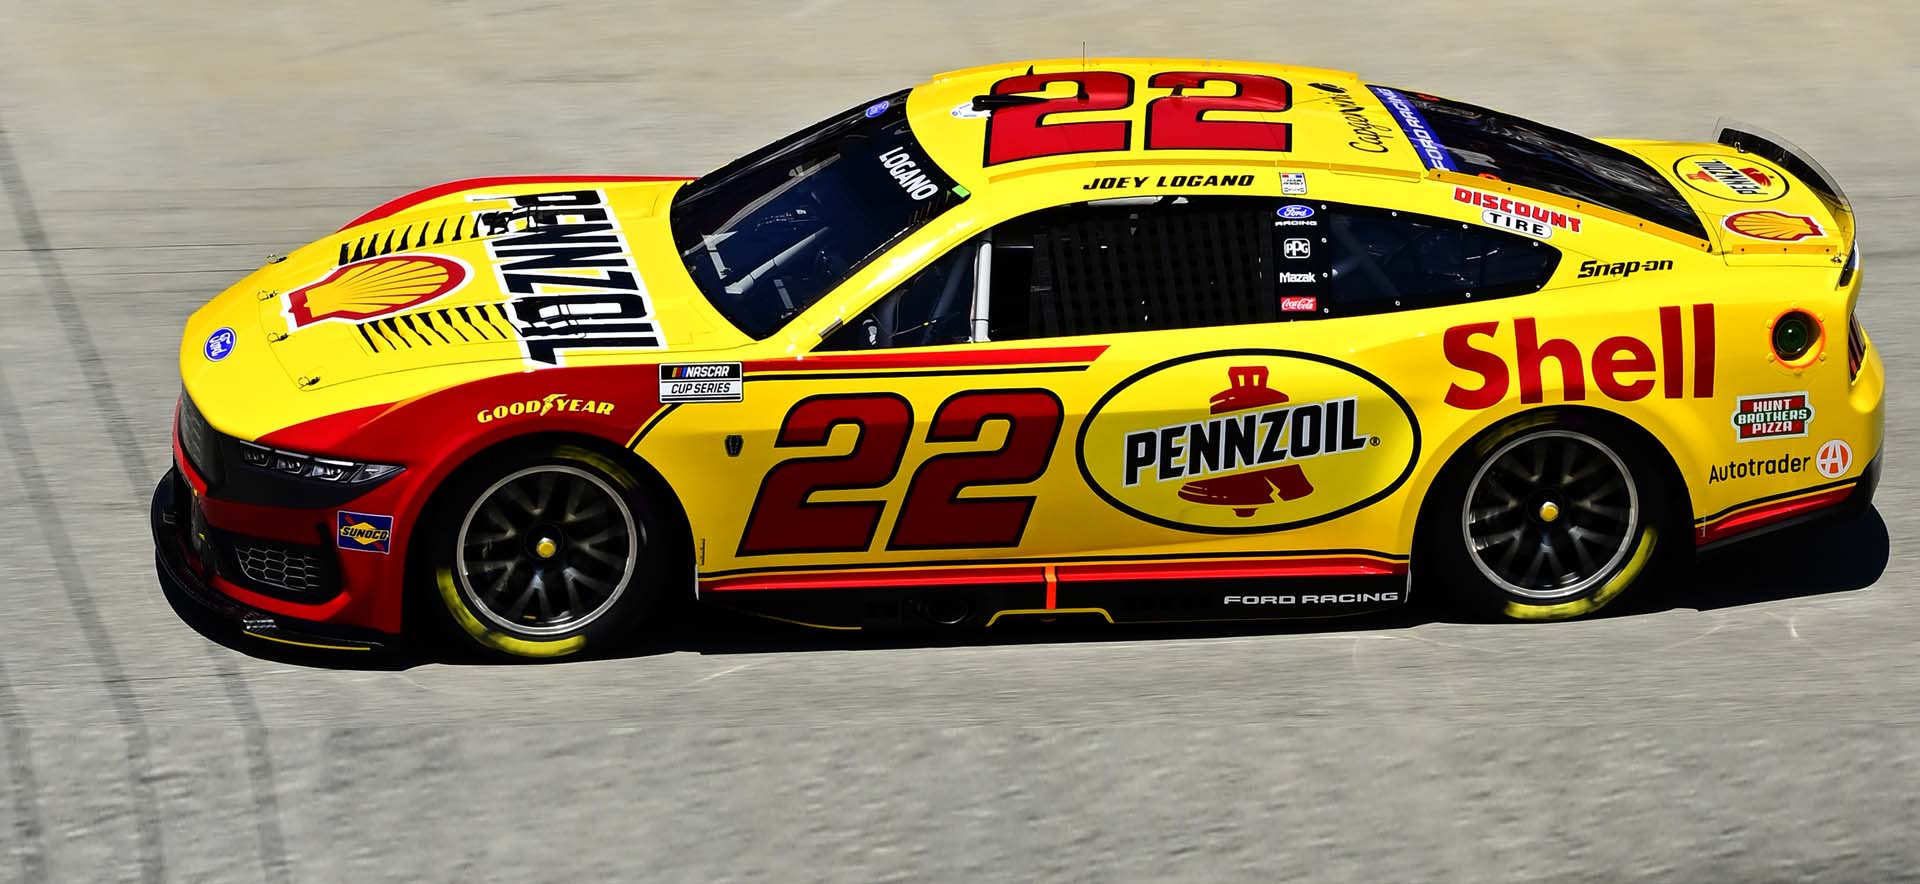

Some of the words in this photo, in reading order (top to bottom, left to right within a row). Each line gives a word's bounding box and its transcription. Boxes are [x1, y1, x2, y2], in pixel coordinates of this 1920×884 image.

[1376, 87, 1424, 129] RACING
[983, 71, 1292, 168] 22
[1412, 129, 1450, 171] FORD
[879, 146, 938, 200] LOGANO
[1083, 176, 1150, 190] JOEY
[1156, 175, 1255, 187] LOGANO
[1282, 205, 1309, 218] Ford
[1454, 187, 1581, 232] DISCOUNT
[1488, 212, 1544, 235] TIRE
[1286, 240, 1308, 256] PPG
[470, 189, 662, 367] PENNZOIL
[1280, 272, 1316, 283] Mazak
[1577, 259, 1674, 278] Snap-on
[1443, 303, 1716, 410] Shell
[685, 366, 730, 378] NASCAR
[671, 383, 693, 394] CUP
[694, 382, 731, 393] SERIES
[1753, 399, 1792, 412] HUNT
[1738, 409, 1808, 425] BROTHERS
[1752, 421, 1792, 434] PIZZA
[1124, 397, 1369, 487] PENNZOIL
[734, 388, 1065, 557] 22
[1709, 454, 1811, 485] Autotrader
[342, 526, 388, 540] SUNOCO
[1224, 595, 1296, 604] FORD
[1302, 592, 1398, 604] RACING
